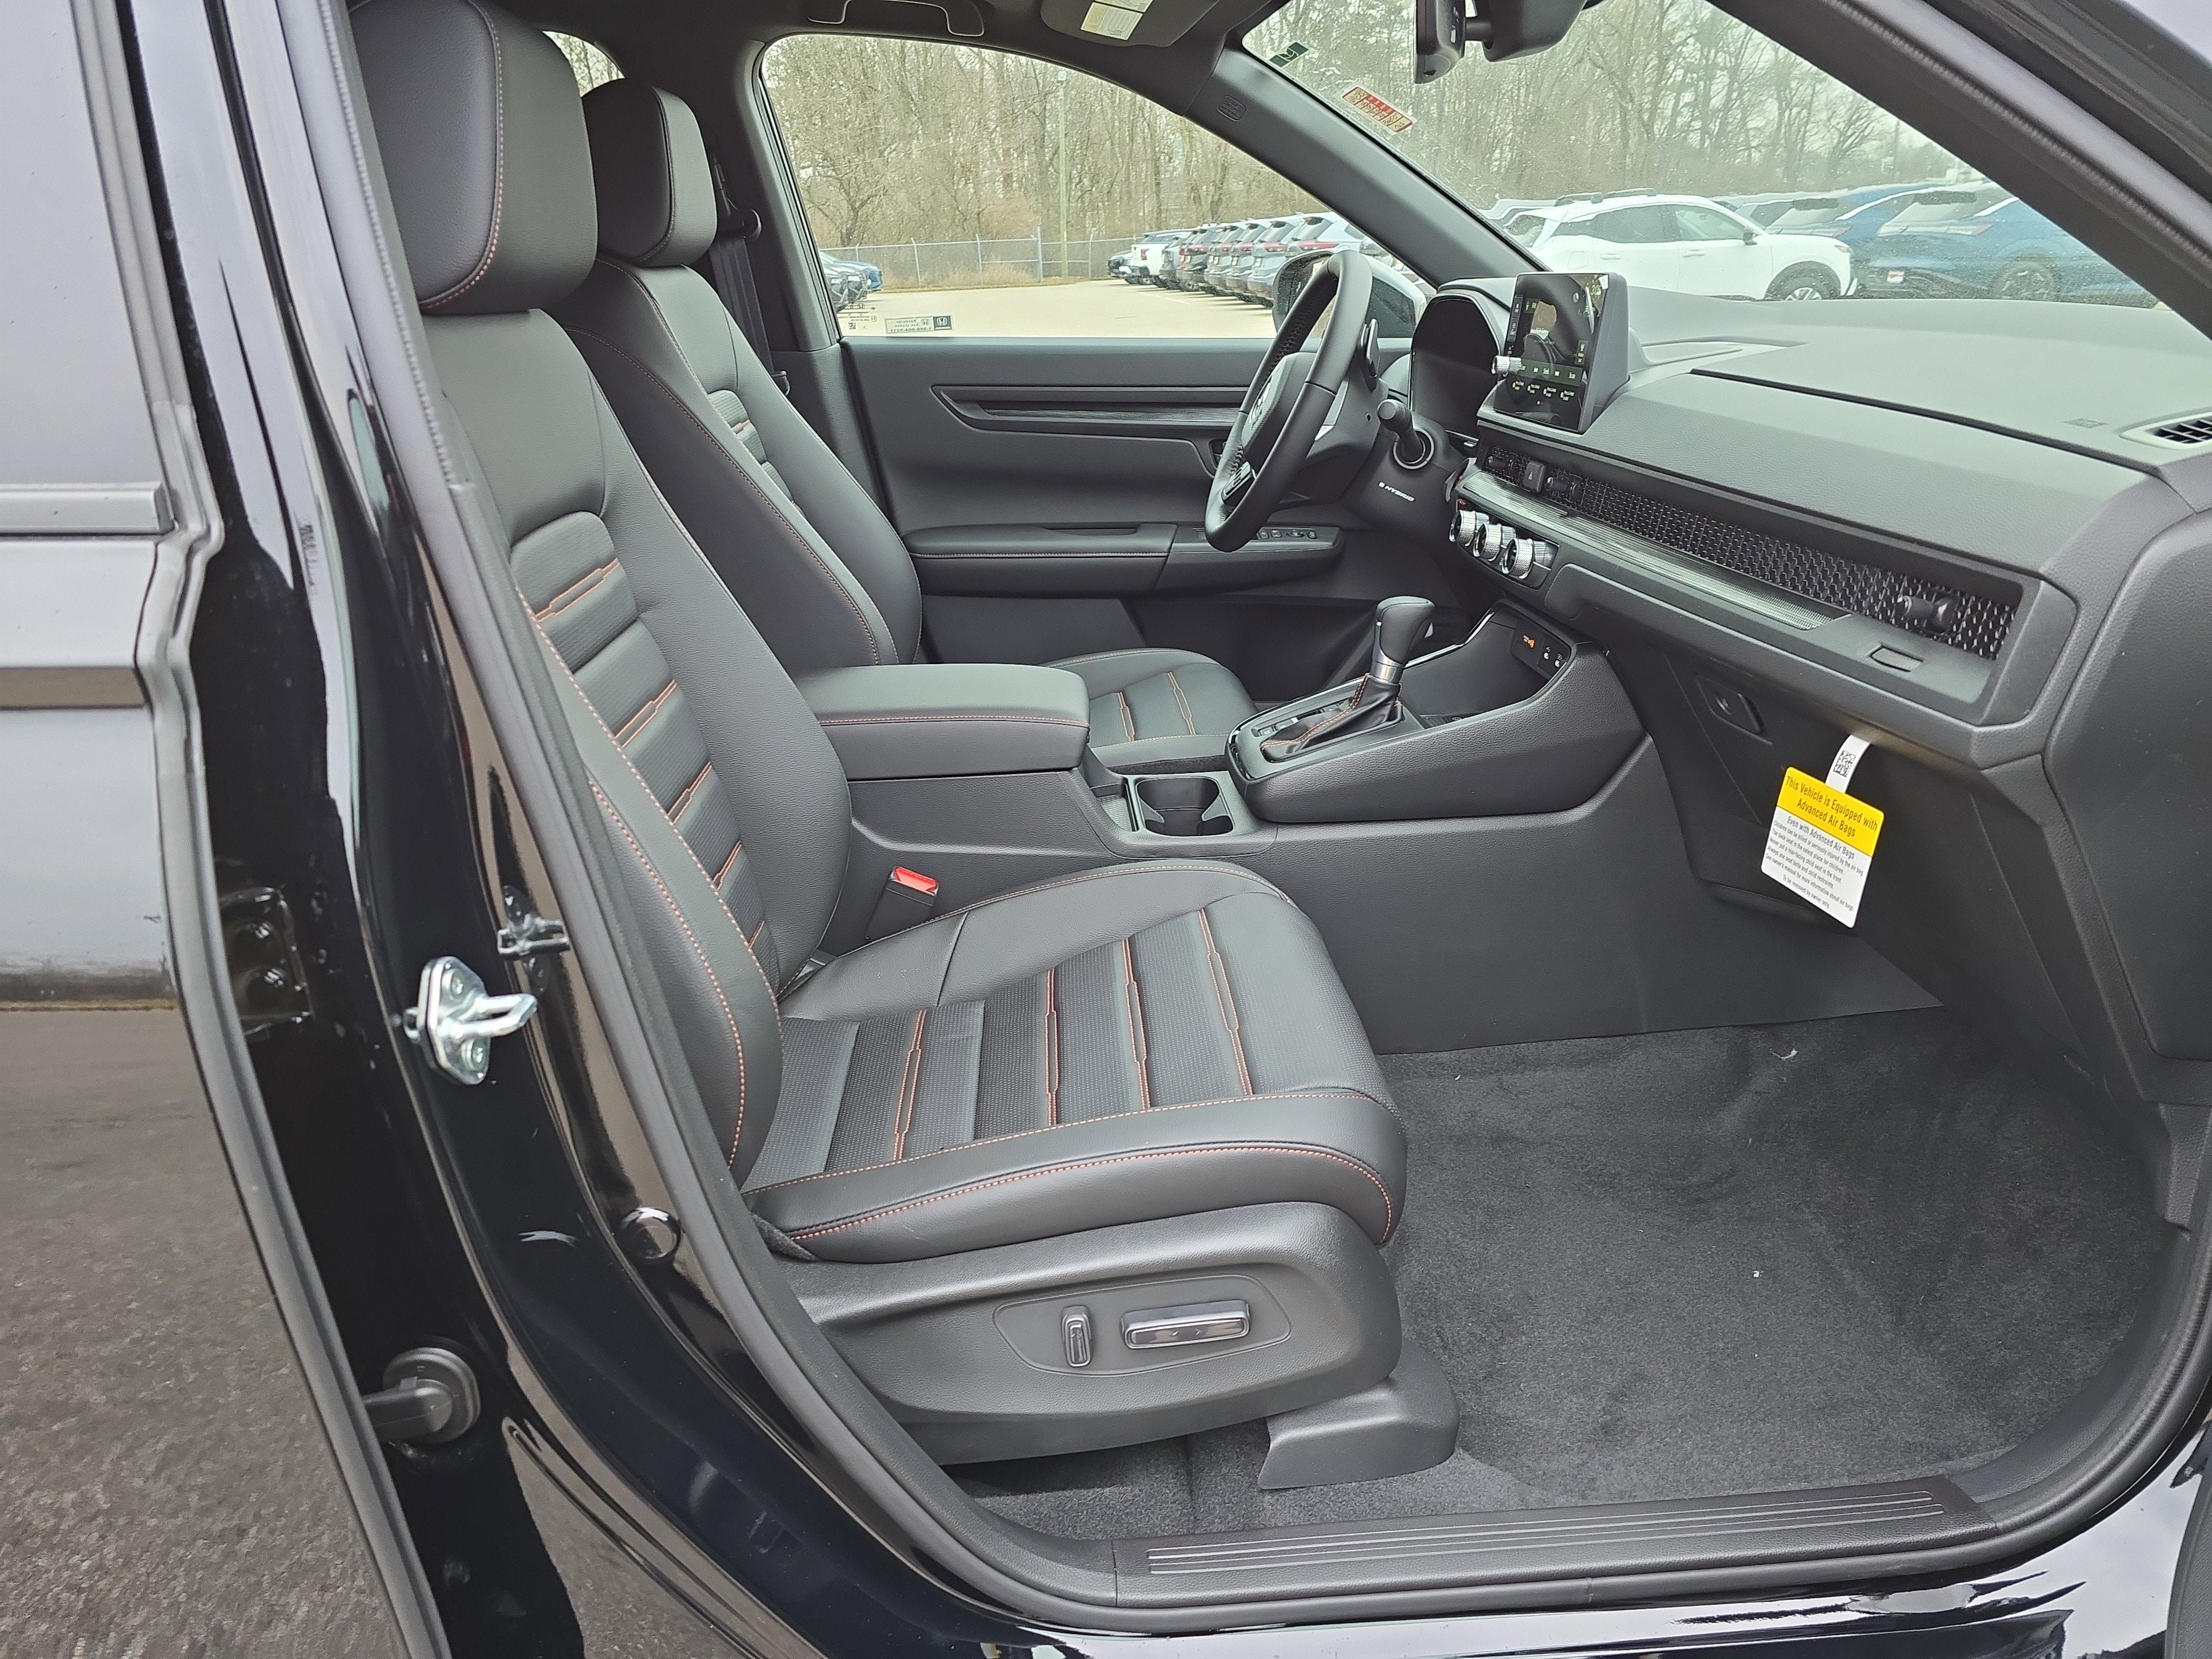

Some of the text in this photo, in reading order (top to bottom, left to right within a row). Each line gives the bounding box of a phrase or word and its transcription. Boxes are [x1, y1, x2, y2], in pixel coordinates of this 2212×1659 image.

[1384, 485, 1414, 501] HYBRID
[1786, 776, 1877, 831] This Vehicle is Equipped with
[1797, 799, 1855, 837] Advanced Air Bags
[1787, 816, 1854, 859] Even with Advanced Air Bags
